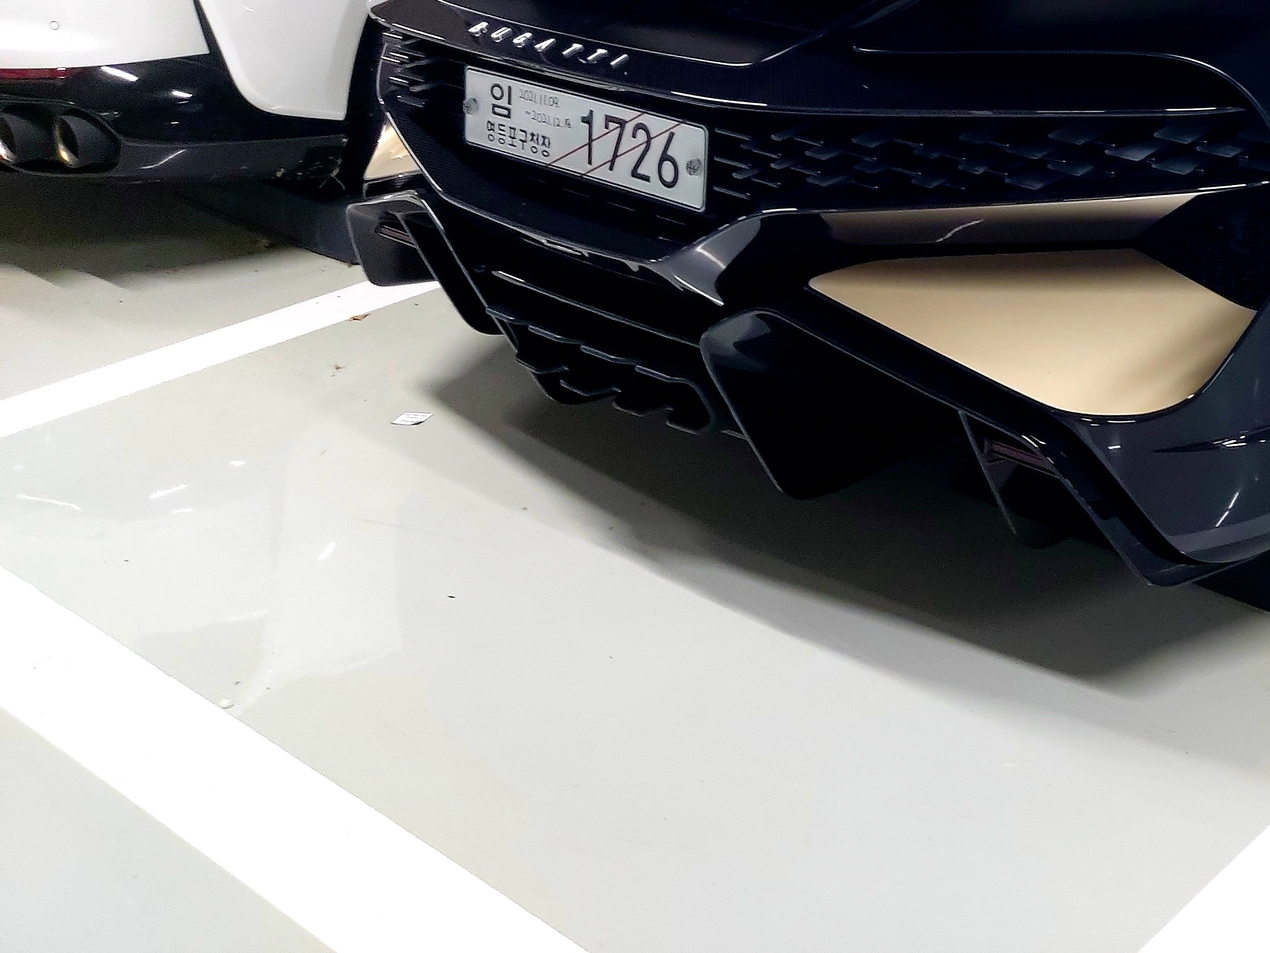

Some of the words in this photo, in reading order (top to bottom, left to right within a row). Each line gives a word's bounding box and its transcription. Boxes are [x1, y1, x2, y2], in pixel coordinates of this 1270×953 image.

[468, 21, 630, 69] BUGATTI
[490, 83, 512, 119] 임
[486, 120, 551, 158] 영등포구청장
[580, 109, 679, 189] 1726
